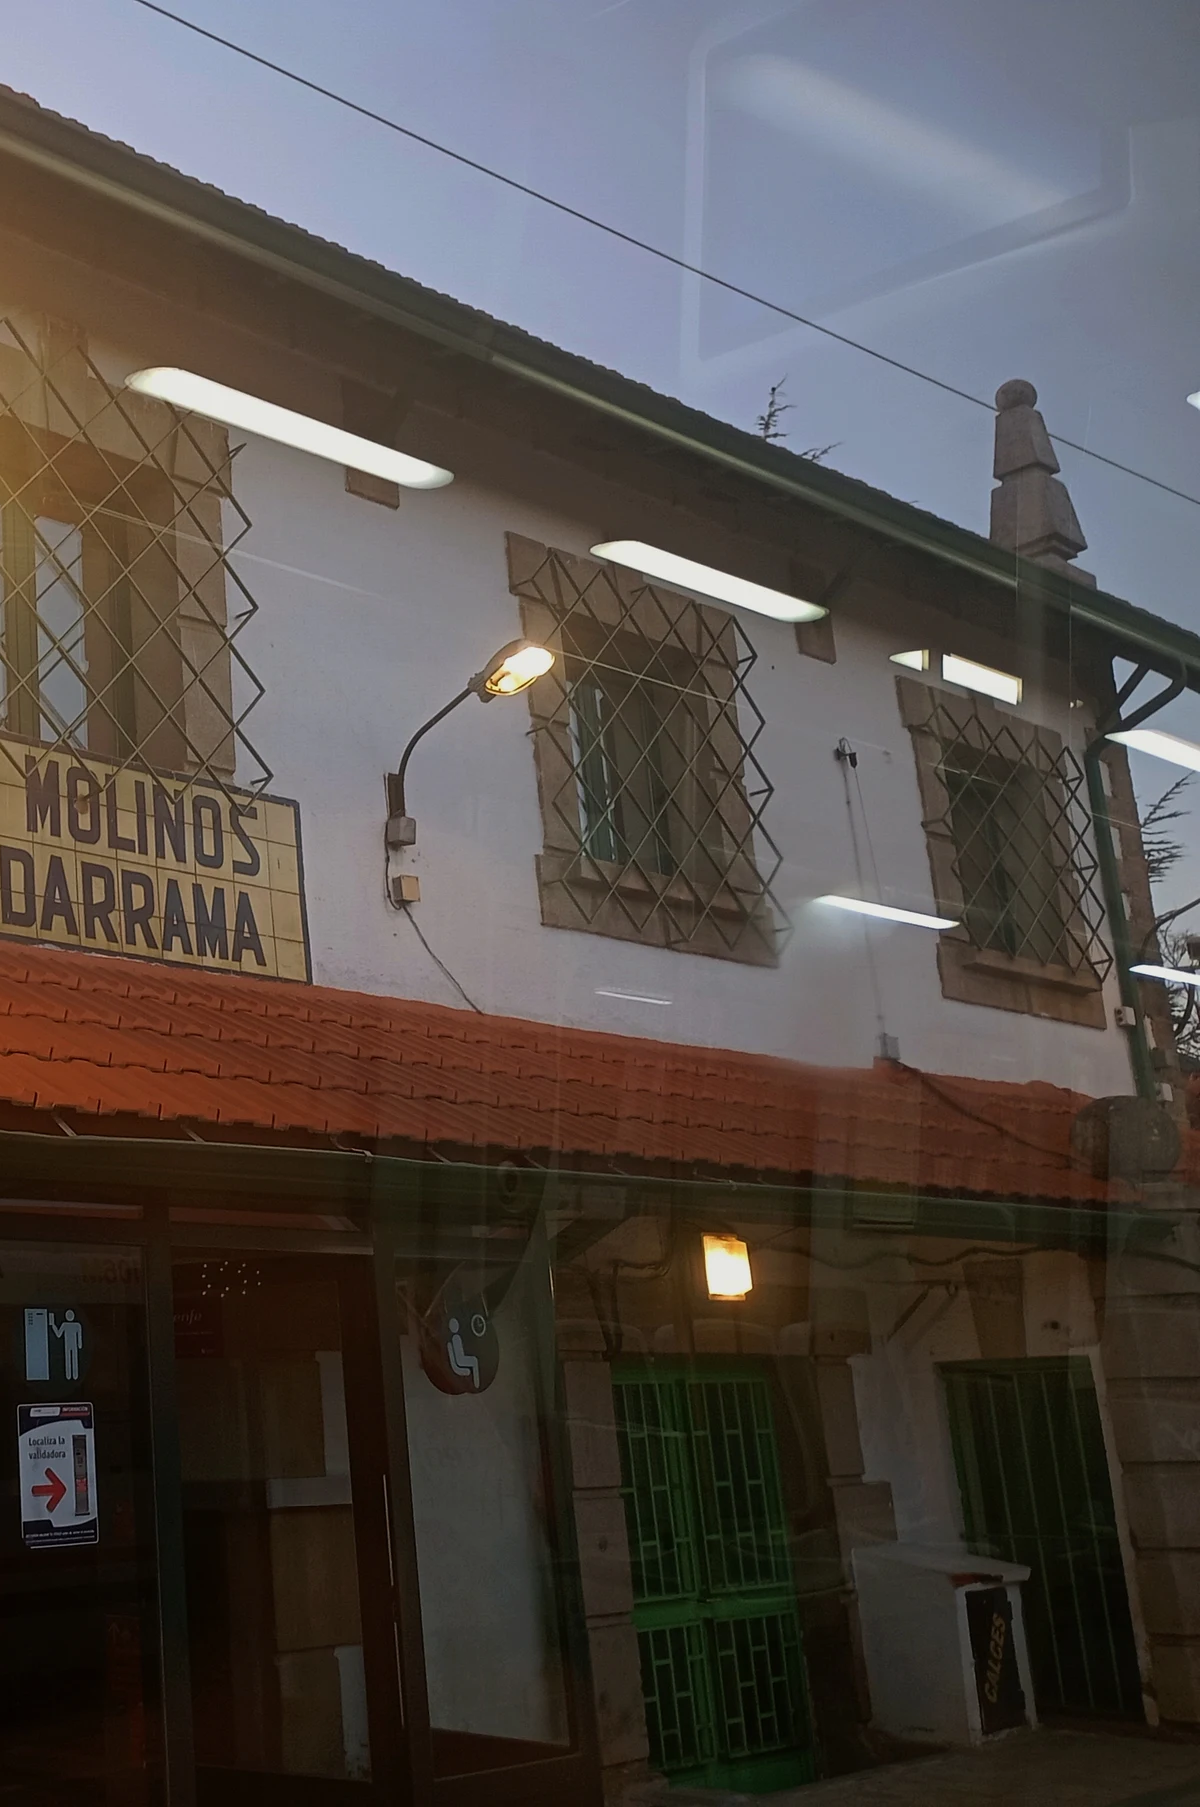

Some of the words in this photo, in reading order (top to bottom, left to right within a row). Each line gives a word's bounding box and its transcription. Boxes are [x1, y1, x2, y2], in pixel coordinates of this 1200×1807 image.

[25, 754, 261, 877] MOLINOS
[28, 1436, 57, 1447] Localiza
[58, 1435, 66, 1445] la
[28, 1449, 66, 1460] validadora
